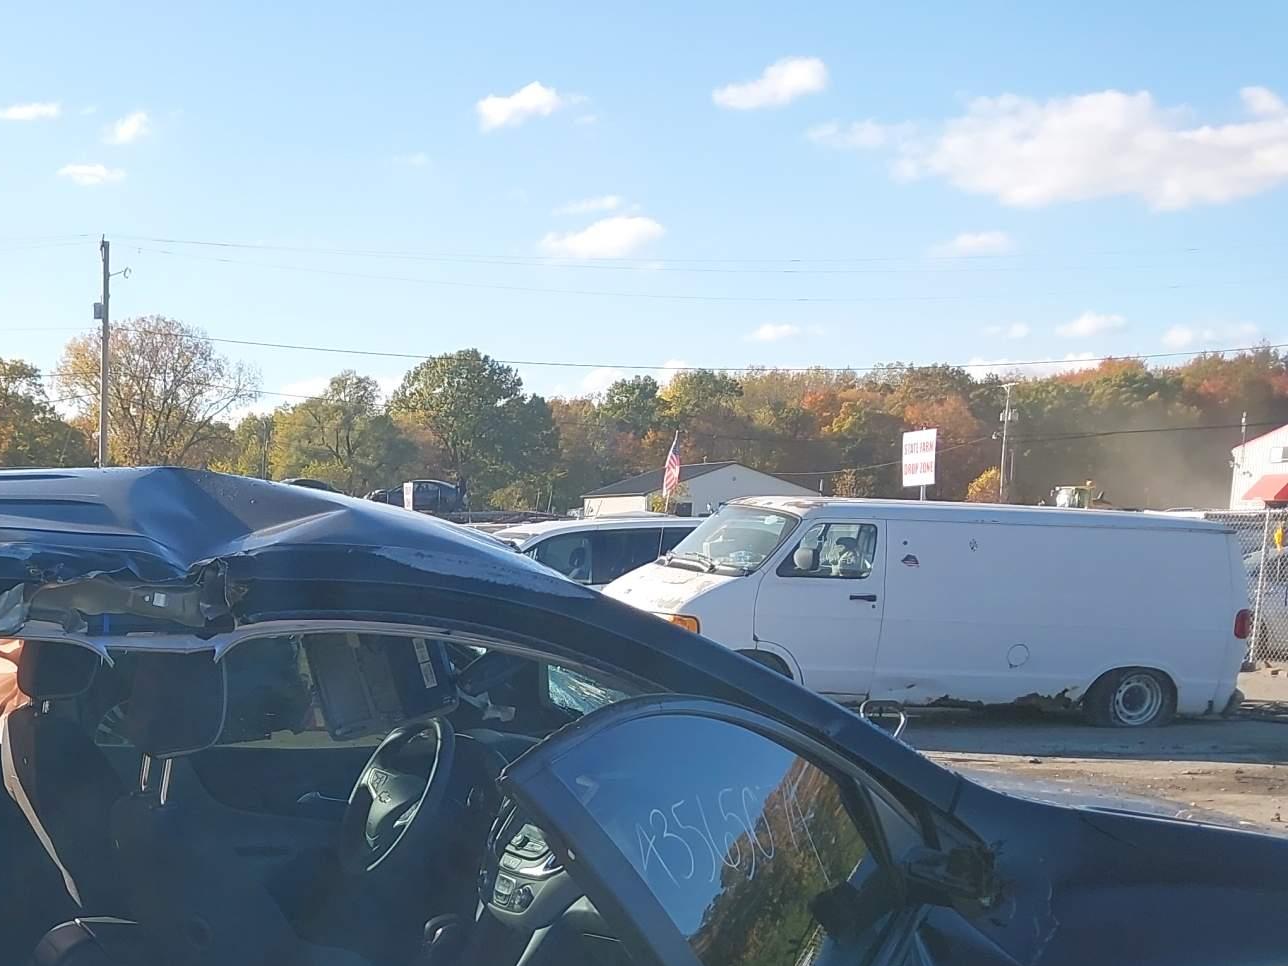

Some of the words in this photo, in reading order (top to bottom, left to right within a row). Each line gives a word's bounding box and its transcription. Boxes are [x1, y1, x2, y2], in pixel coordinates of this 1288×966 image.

[904, 442, 919, 455] STATE
[919, 440, 934, 453] FARM
[919, 461, 934, 473] ZONE
